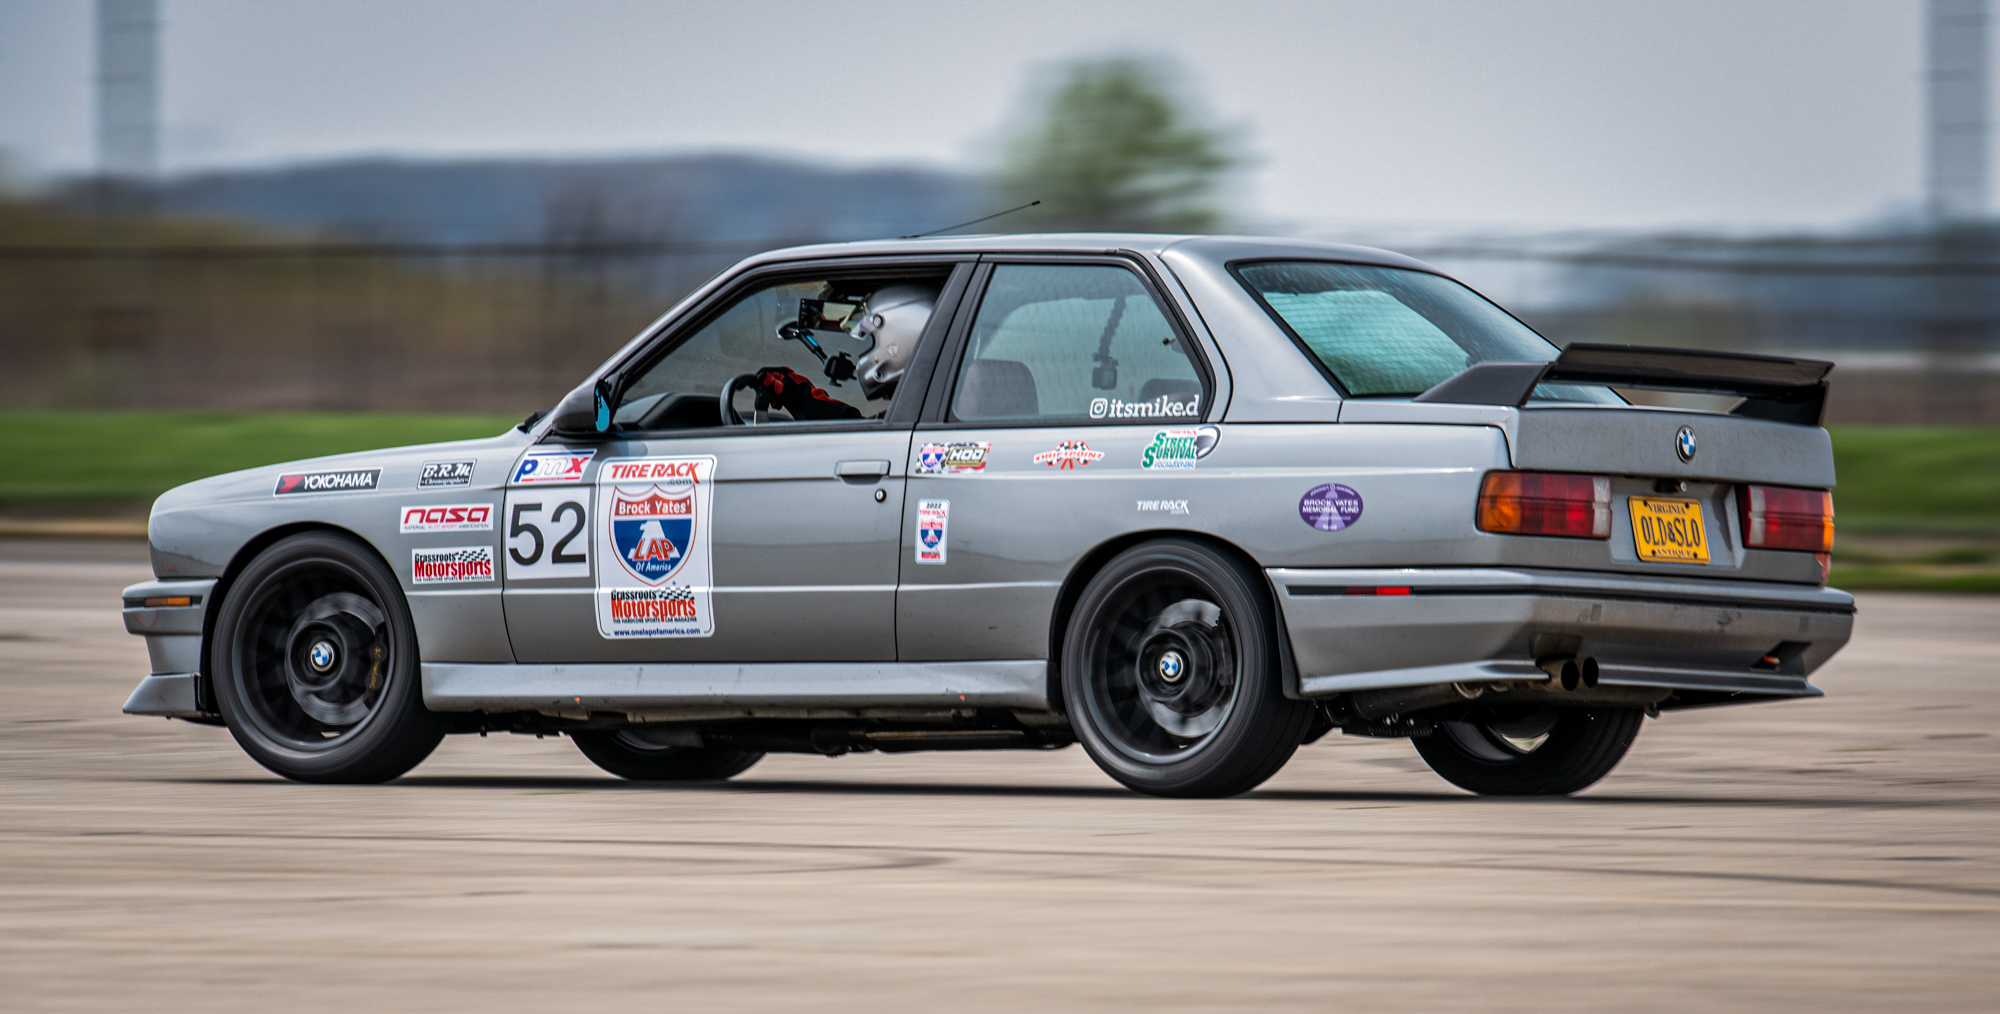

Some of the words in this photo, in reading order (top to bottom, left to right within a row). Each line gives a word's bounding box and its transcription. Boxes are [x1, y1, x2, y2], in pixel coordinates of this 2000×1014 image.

[1108, 395, 1200, 418] itsmike.d
[1153, 432, 1196, 447] STREET
[1142, 447, 1196, 468] SURVIVAL
[304, 472, 373, 490] YOKOHAMA
[612, 464, 651, 479] TIRE
[650, 462, 701, 485] RACK
[618, 501, 651, 515] Brock
[655, 498, 691, 514] Yates'
[1136, 499, 1160, 511] TIRE
[1160, 499, 1189, 515] RACK
[1302, 506, 1337, 514] MEMORIAL
[1340, 506, 1359, 514] FUND
[1647, 503, 1686, 515] VIRGINIA
[508, 500, 586, 566] 52
[1641, 515, 1701, 547] OLD&SLO
[414, 552, 457, 562] Grassroots
[632, 538, 675, 562] LAP
[1656, 548, 1692, 557] ANTIQUE
[414, 559, 492, 581] Motorsports
[635, 562, 645, 572] Of
[645, 562, 672, 572] America
[611, 589, 657, 600] Grassroots
[610, 597, 697, 623] Motorsports
[613, 627, 701, 638] www.onelapofamerica.com
